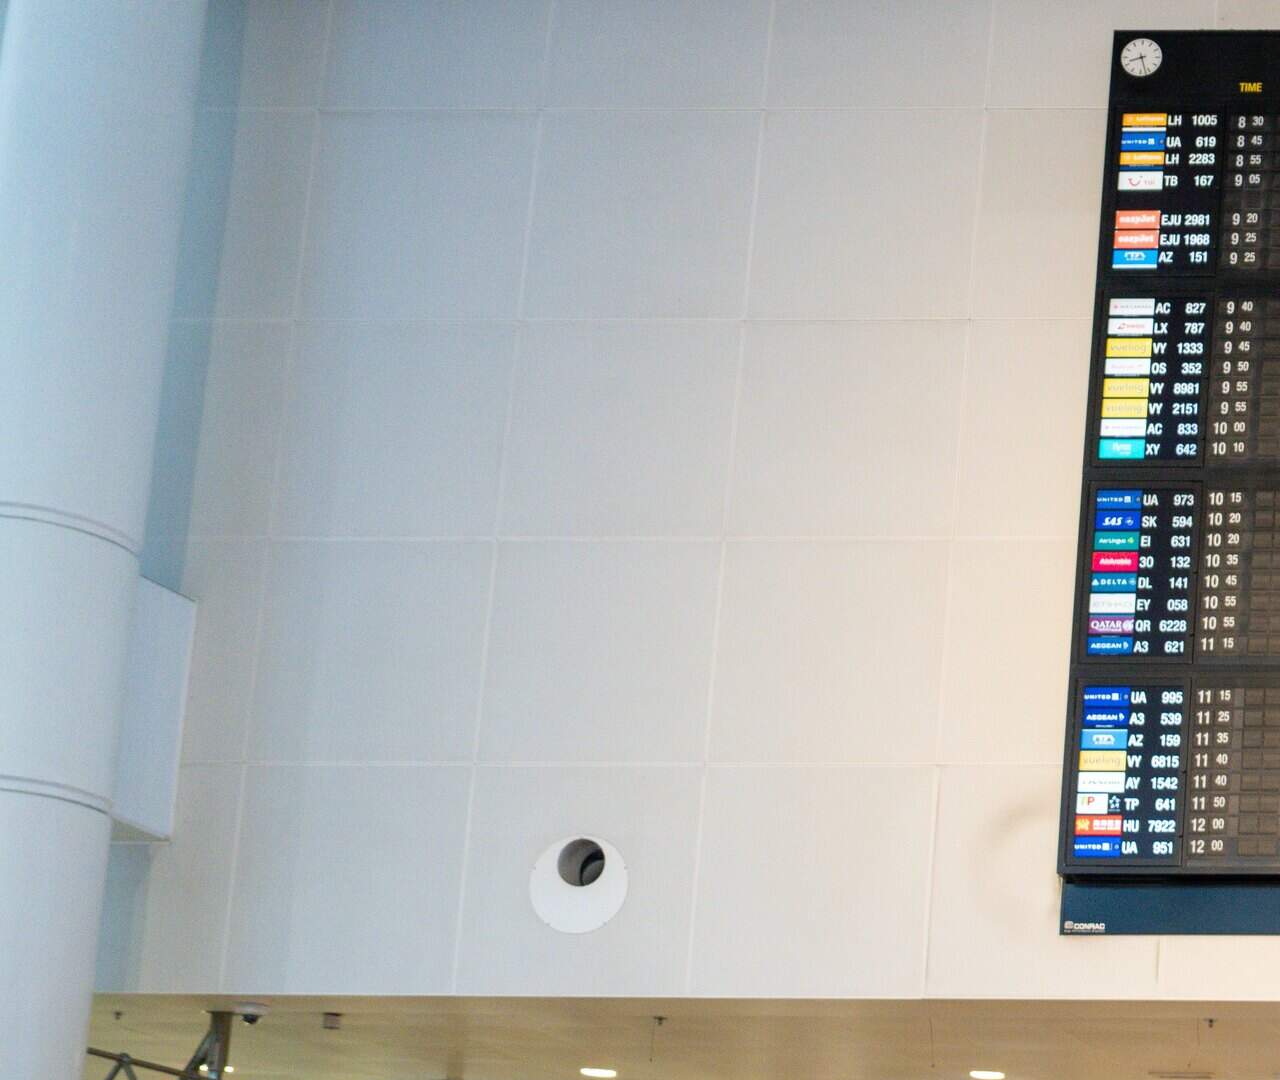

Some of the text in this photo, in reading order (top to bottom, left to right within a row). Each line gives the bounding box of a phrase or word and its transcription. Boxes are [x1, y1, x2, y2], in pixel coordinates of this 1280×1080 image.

[1240, 83, 1262, 92] TIME
[1168, 115, 1182, 125] LH
[1192, 115, 1217, 126] 1005
[1238, 116, 1246, 128] 8
[1252, 116, 1264, 126] 30
[1103, 517, 1123, 526] SAS
[1138, 577, 1152, 589] DL
[1170, 577, 1187, 588] 141
[1091, 620, 1122, 629] QATAR
